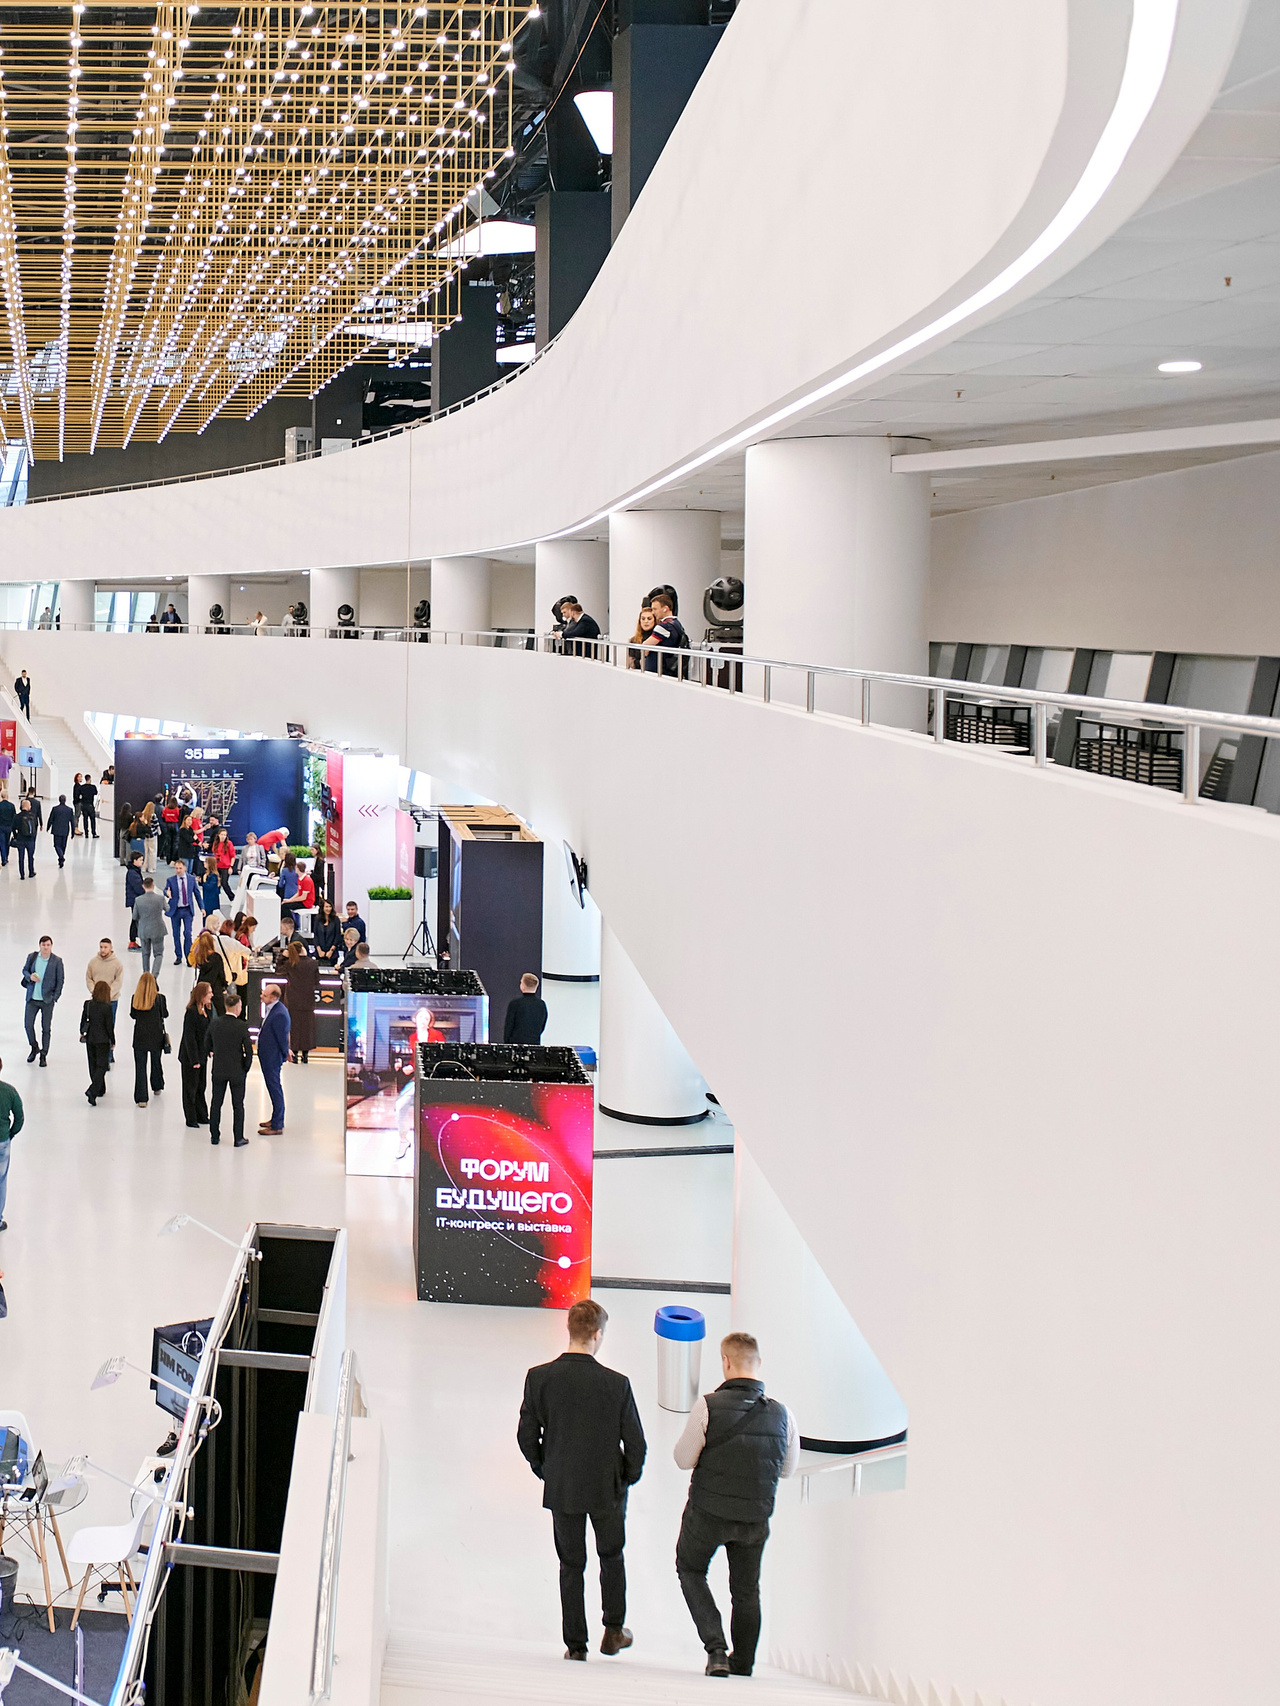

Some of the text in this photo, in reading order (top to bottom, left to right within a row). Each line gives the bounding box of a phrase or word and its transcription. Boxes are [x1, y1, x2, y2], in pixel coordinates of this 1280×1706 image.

[184, 748, 202, 760] 35
[460, 1158, 550, 1182] ФОРУМ
[436, 1217, 572, 1233] IT-конгресс и выставка
